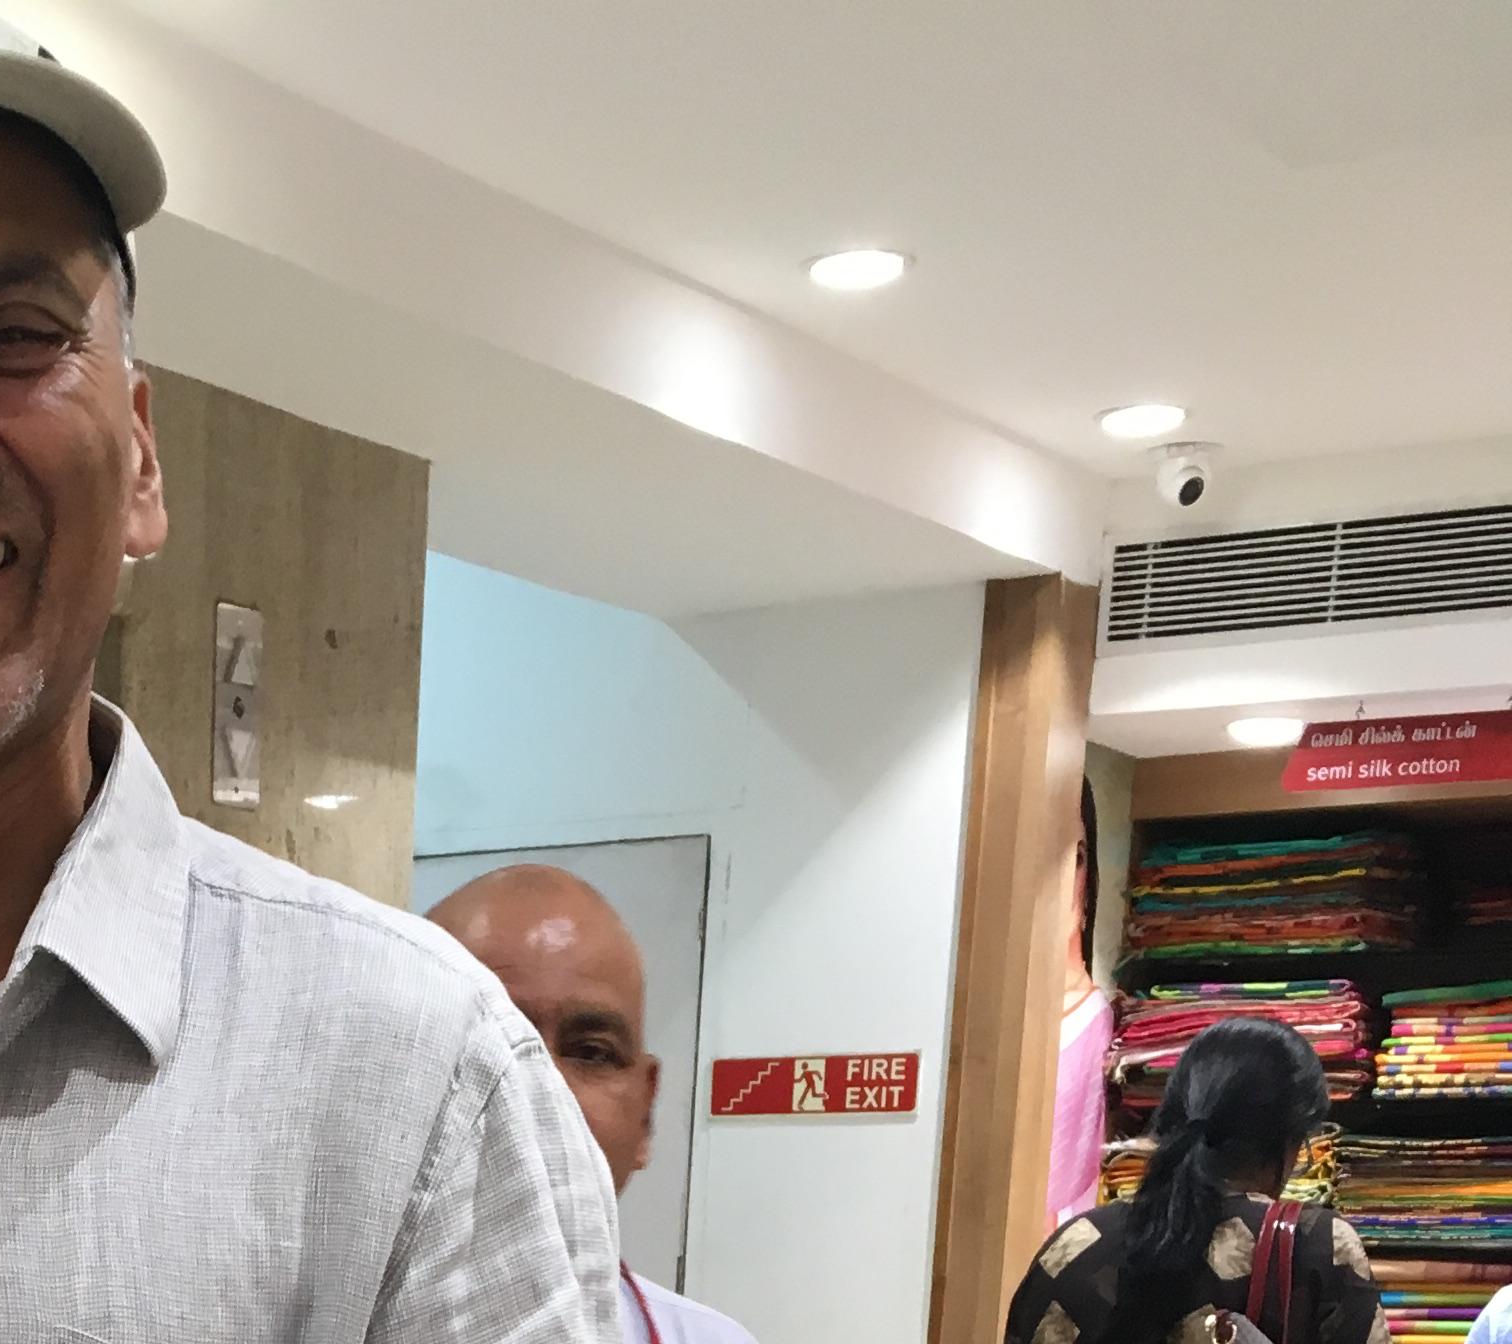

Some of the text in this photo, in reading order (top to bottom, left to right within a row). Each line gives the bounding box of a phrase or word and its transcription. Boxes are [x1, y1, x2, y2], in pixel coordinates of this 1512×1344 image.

[1306, 757, 1460, 781] semi silk cotton
[846, 1058, 907, 1082] FIRE
[845, 1086, 904, 1109] EXIT
